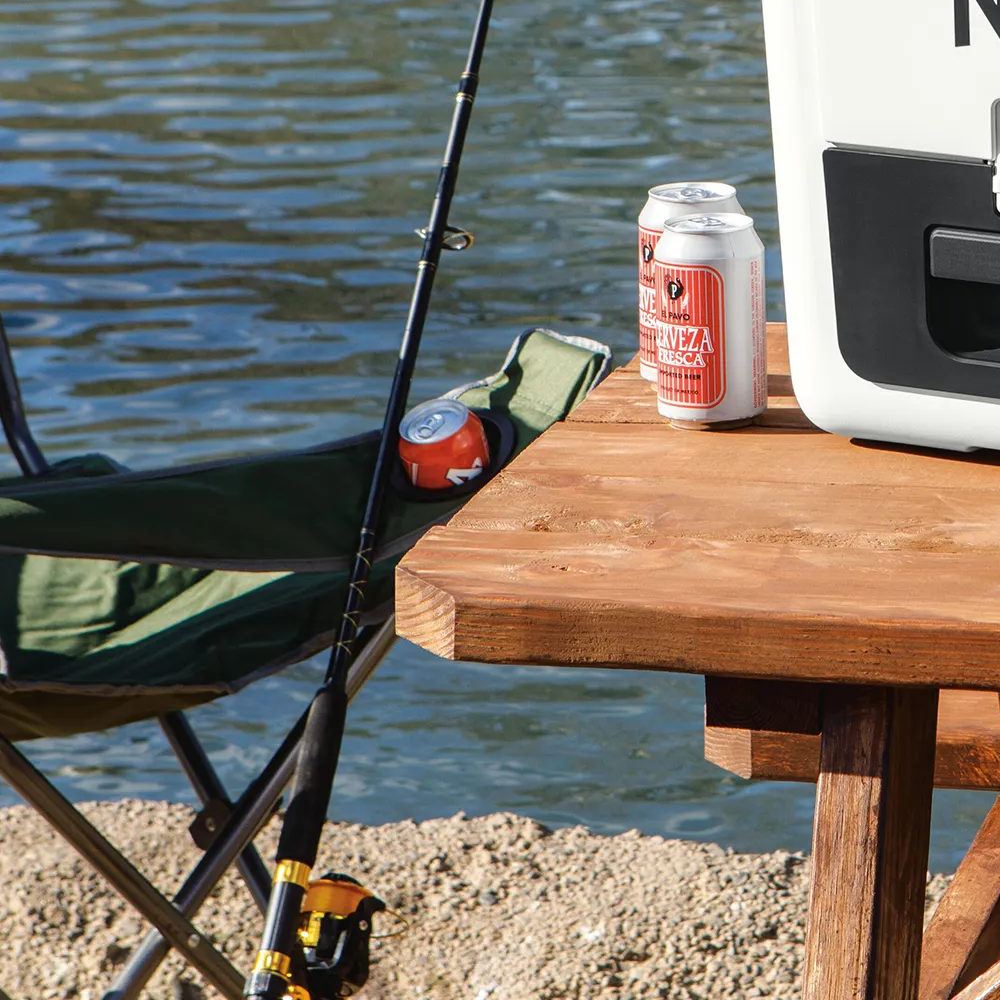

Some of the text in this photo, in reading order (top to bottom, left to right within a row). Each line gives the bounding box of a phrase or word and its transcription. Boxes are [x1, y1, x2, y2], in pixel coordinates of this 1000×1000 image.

[671, 284, 678, 297] P
[661, 310, 690, 321] EL PAVO
[657, 320, 714, 353] ERVEZA
[658, 347, 706, 367] FRESCA
